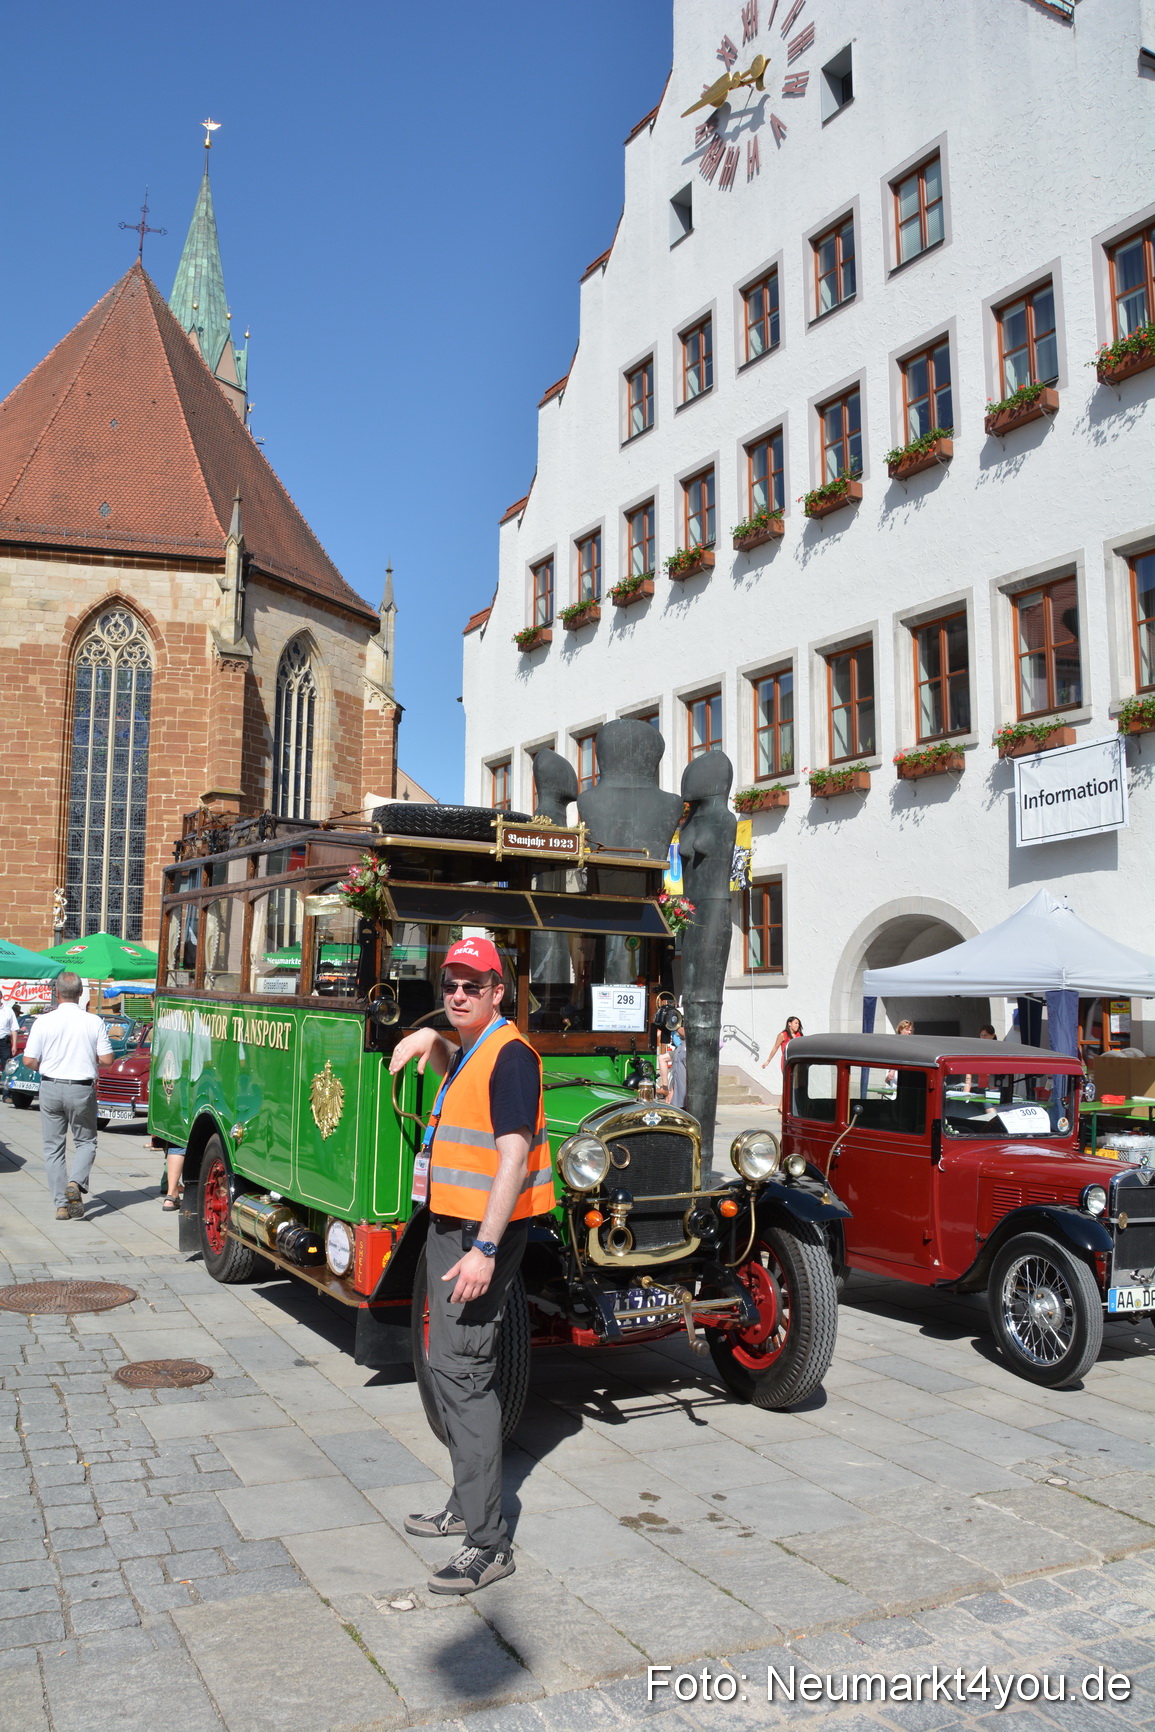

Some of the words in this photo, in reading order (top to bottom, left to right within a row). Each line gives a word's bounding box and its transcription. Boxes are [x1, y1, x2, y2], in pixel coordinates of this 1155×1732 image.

[1023, 778, 1118, 810] Information
[507, 833, 546, 848] Baujahr
[548, 838, 574, 849] 1923
[453, 947, 479, 957] DEKRA
[267, 957, 302, 965] Neumarkte
[616, 994, 635, 1005] 298
[199, 1012, 228, 1041] MOTOR
[232, 1016, 292, 1051] TRANSPORT
[1019, 1108, 1037, 1117] 300
[1117, 1291, 1134, 1308] AA
